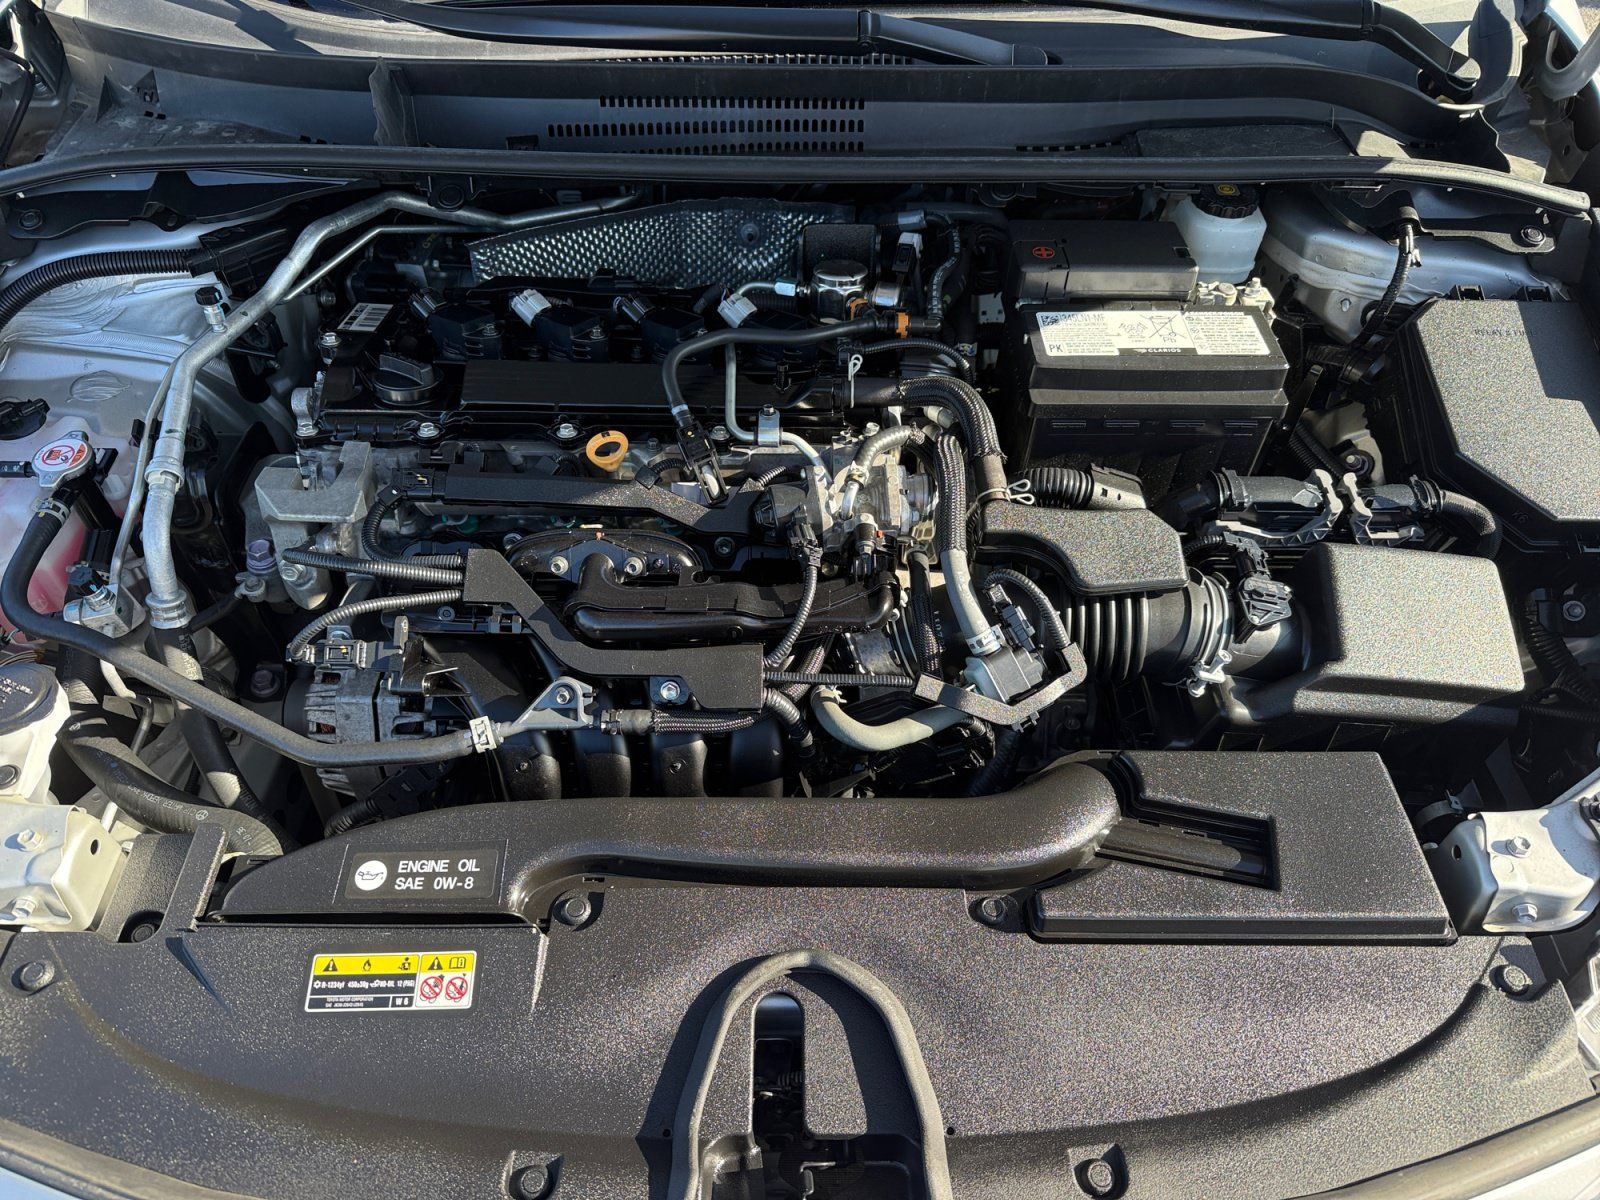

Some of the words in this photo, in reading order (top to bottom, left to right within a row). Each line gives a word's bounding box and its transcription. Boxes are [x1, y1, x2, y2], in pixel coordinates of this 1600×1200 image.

[1049, 344, 1063, 353] PK
[398, 860, 449, 873] ENGINE
[458, 859, 481, 872] OIL
[395, 877, 424, 890] SAE
[434, 877, 474, 890] 0W-8
